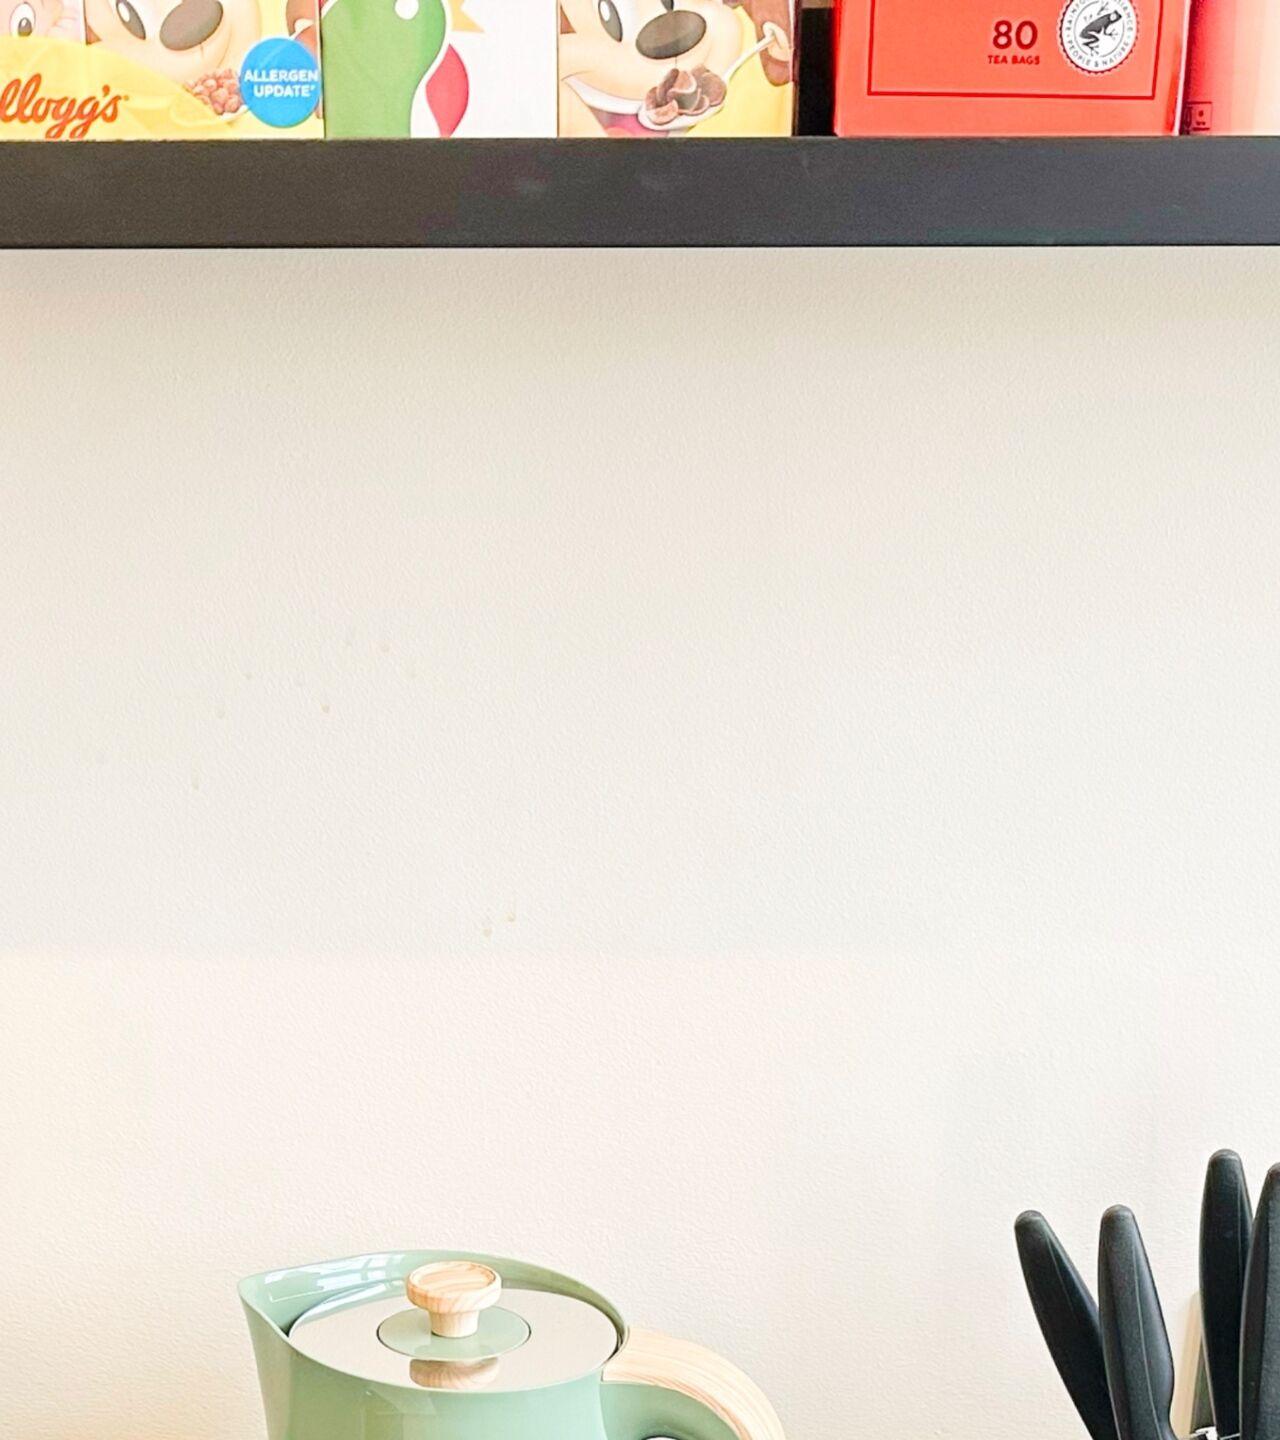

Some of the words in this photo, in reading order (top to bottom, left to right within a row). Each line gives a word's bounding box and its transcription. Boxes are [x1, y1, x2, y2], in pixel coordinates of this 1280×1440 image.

[993, 20, 1037, 49] 80
[988, 55, 1008, 65] TEA
[1012, 55, 1040, 65] BAGS
[243, 69, 319, 83] ALLERGEN
